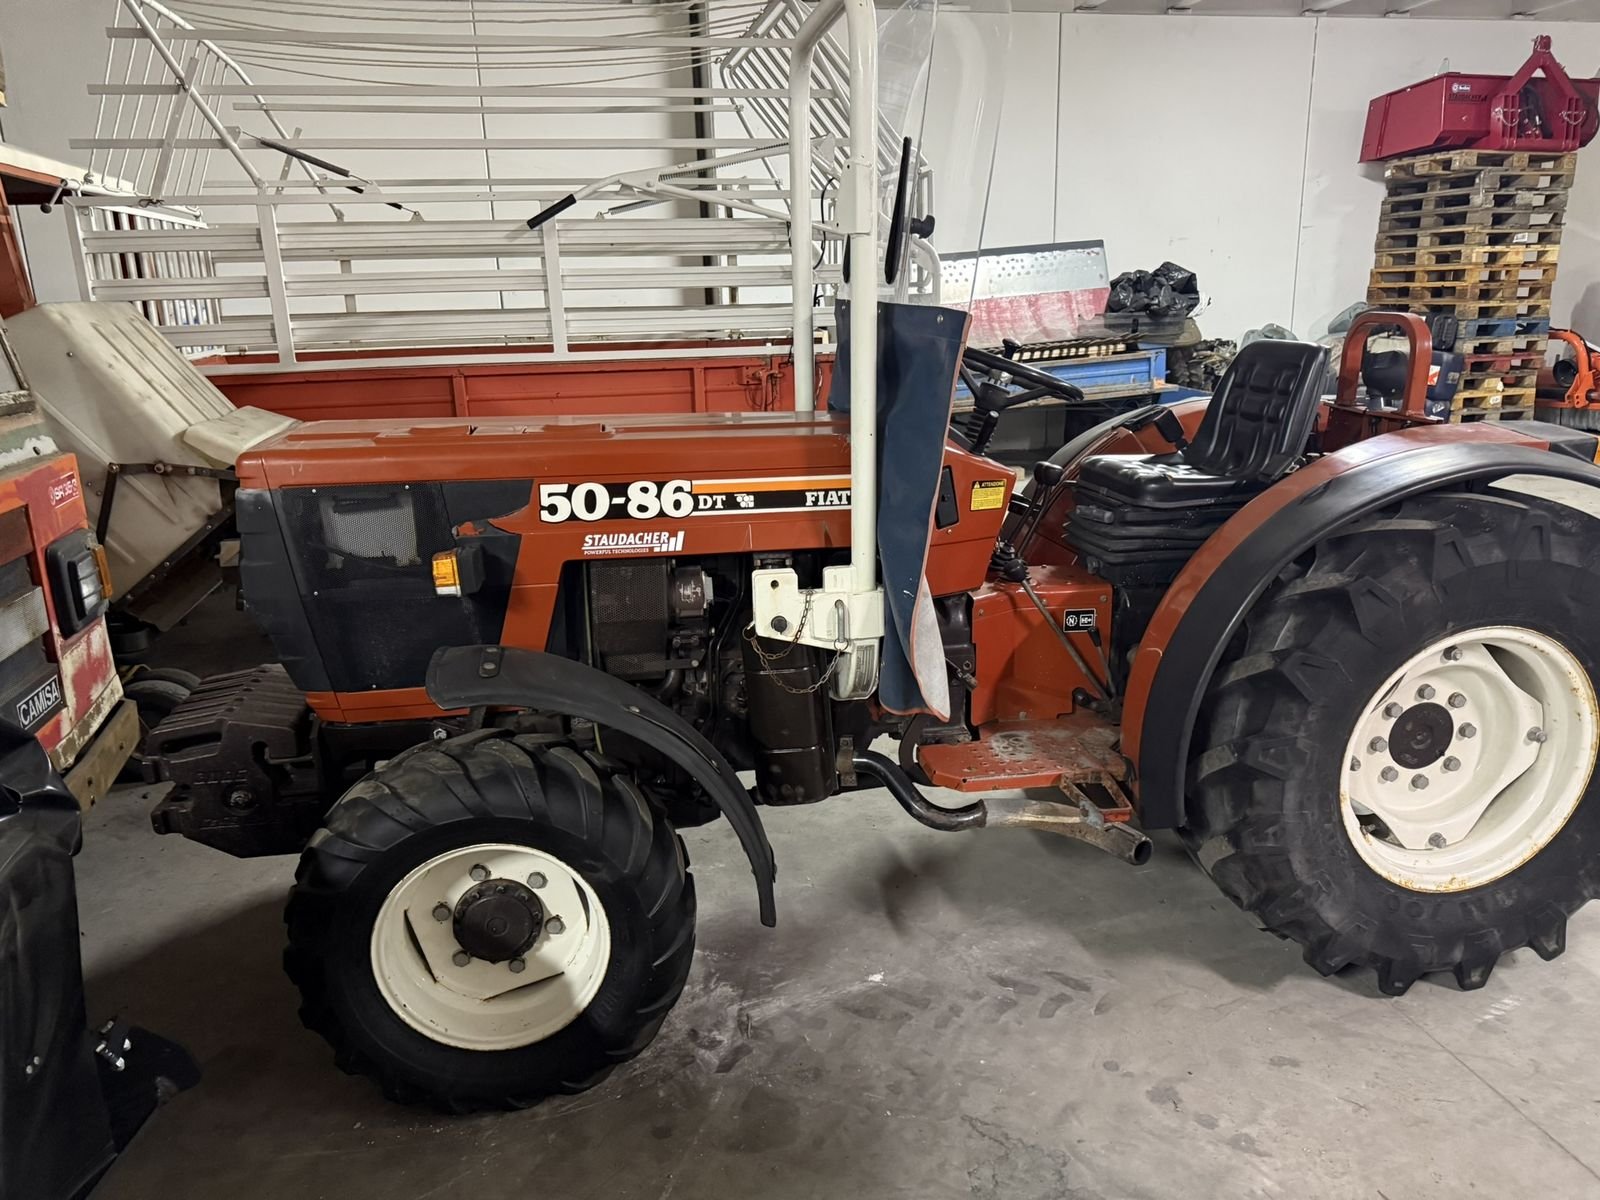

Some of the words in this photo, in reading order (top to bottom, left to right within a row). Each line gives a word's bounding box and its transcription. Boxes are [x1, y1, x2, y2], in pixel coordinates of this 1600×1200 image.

[539, 480, 694, 523] 50-86
[698, 495, 727, 509] DT
[805, 490, 851, 506] FIAT
[583, 531, 670, 547] STAUDACHER
[20, 681, 60, 726] CAMISA
